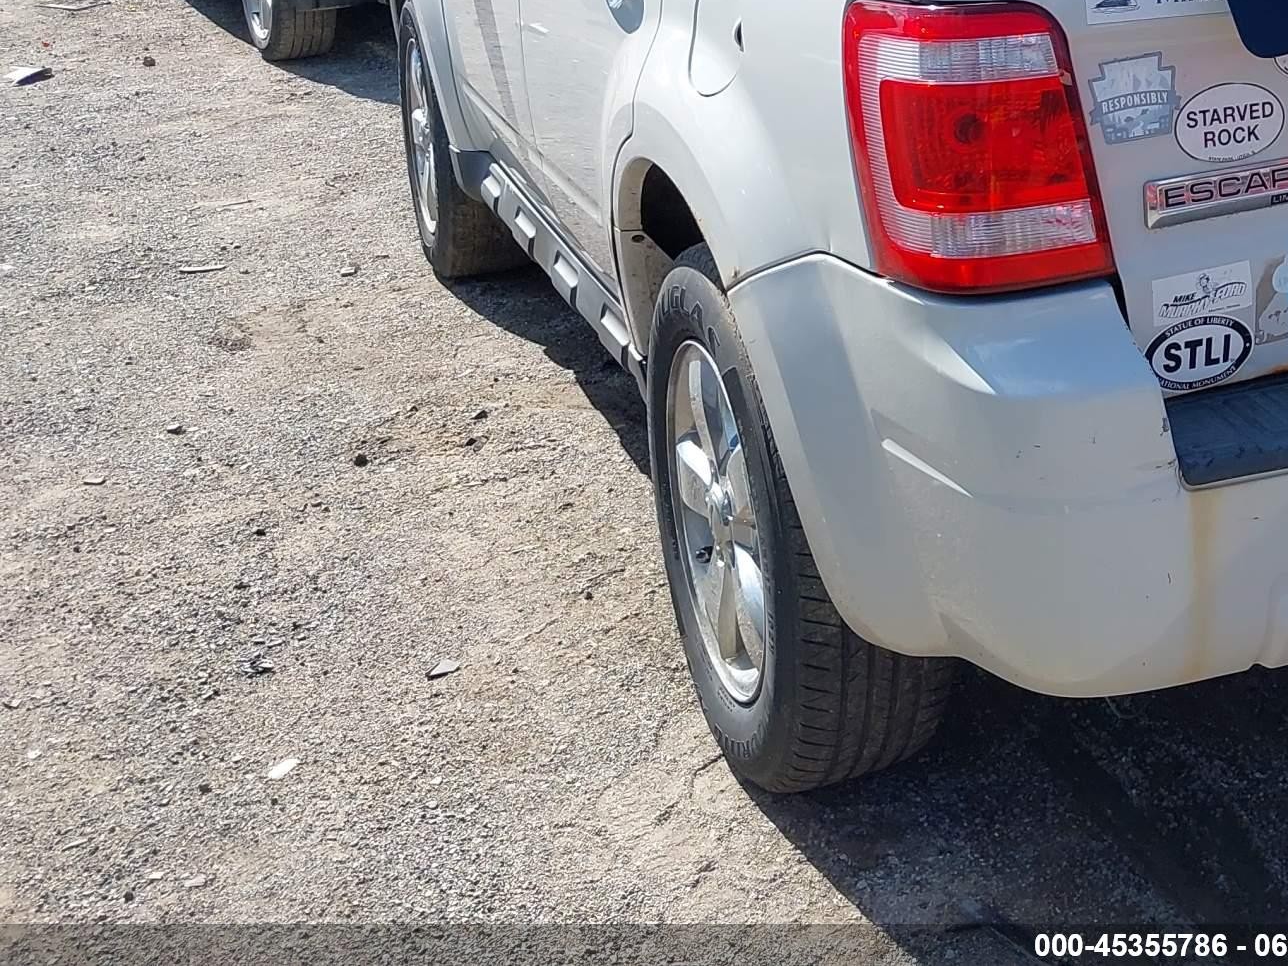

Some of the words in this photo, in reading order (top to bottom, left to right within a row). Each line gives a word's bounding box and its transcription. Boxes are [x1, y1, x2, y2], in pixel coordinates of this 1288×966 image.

[1101, 91, 1168, 113] RESPONSIBLY
[1186, 101, 1274, 129] STARVED
[1203, 124, 1260, 148] ROCK
[1173, 292, 1198, 303] MIKE
[1165, 318, 1194, 337] STATUE
[1194, 316, 1205, 325] OF
[1206, 316, 1235, 326] LIBERTY
[1163, 333, 1232, 374] STLI
[1160, 380, 1190, 389] ATIONAL
[1192, 365, 1236, 388] MONUMENT
